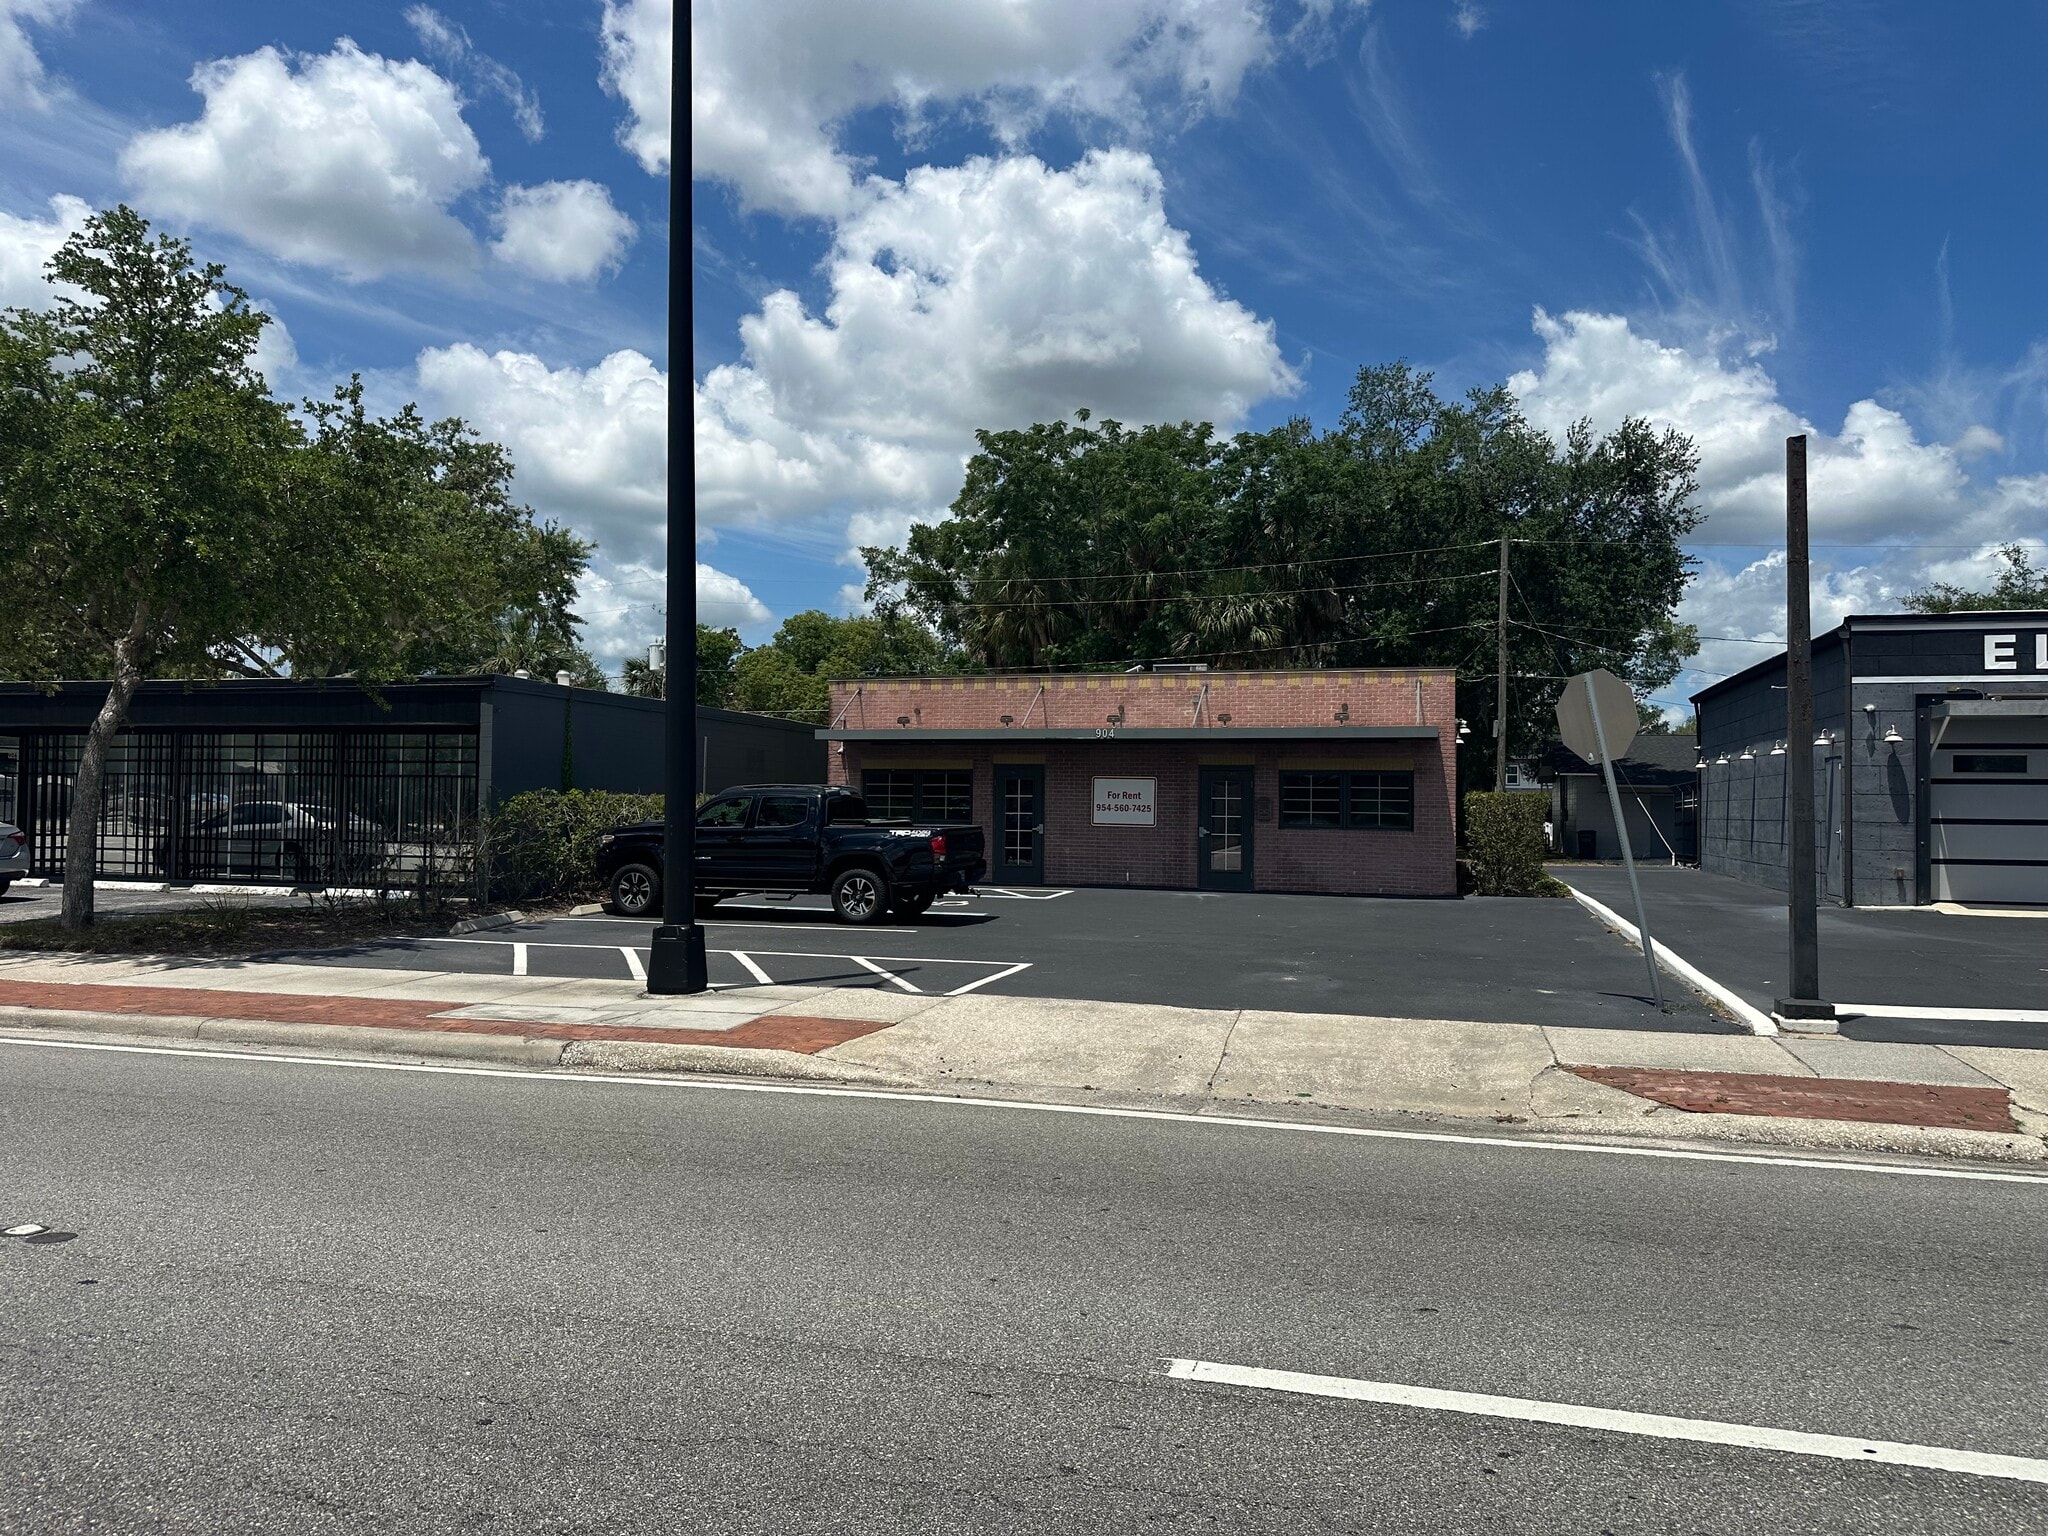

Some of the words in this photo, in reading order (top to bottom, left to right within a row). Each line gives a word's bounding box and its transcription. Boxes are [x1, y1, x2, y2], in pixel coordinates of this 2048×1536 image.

[1095, 728, 1115, 738] 904
[1107, 791, 1121, 800] For
[1122, 791, 1142, 800] Rent
[1096, 803, 1152, 813] 954-560-7425
